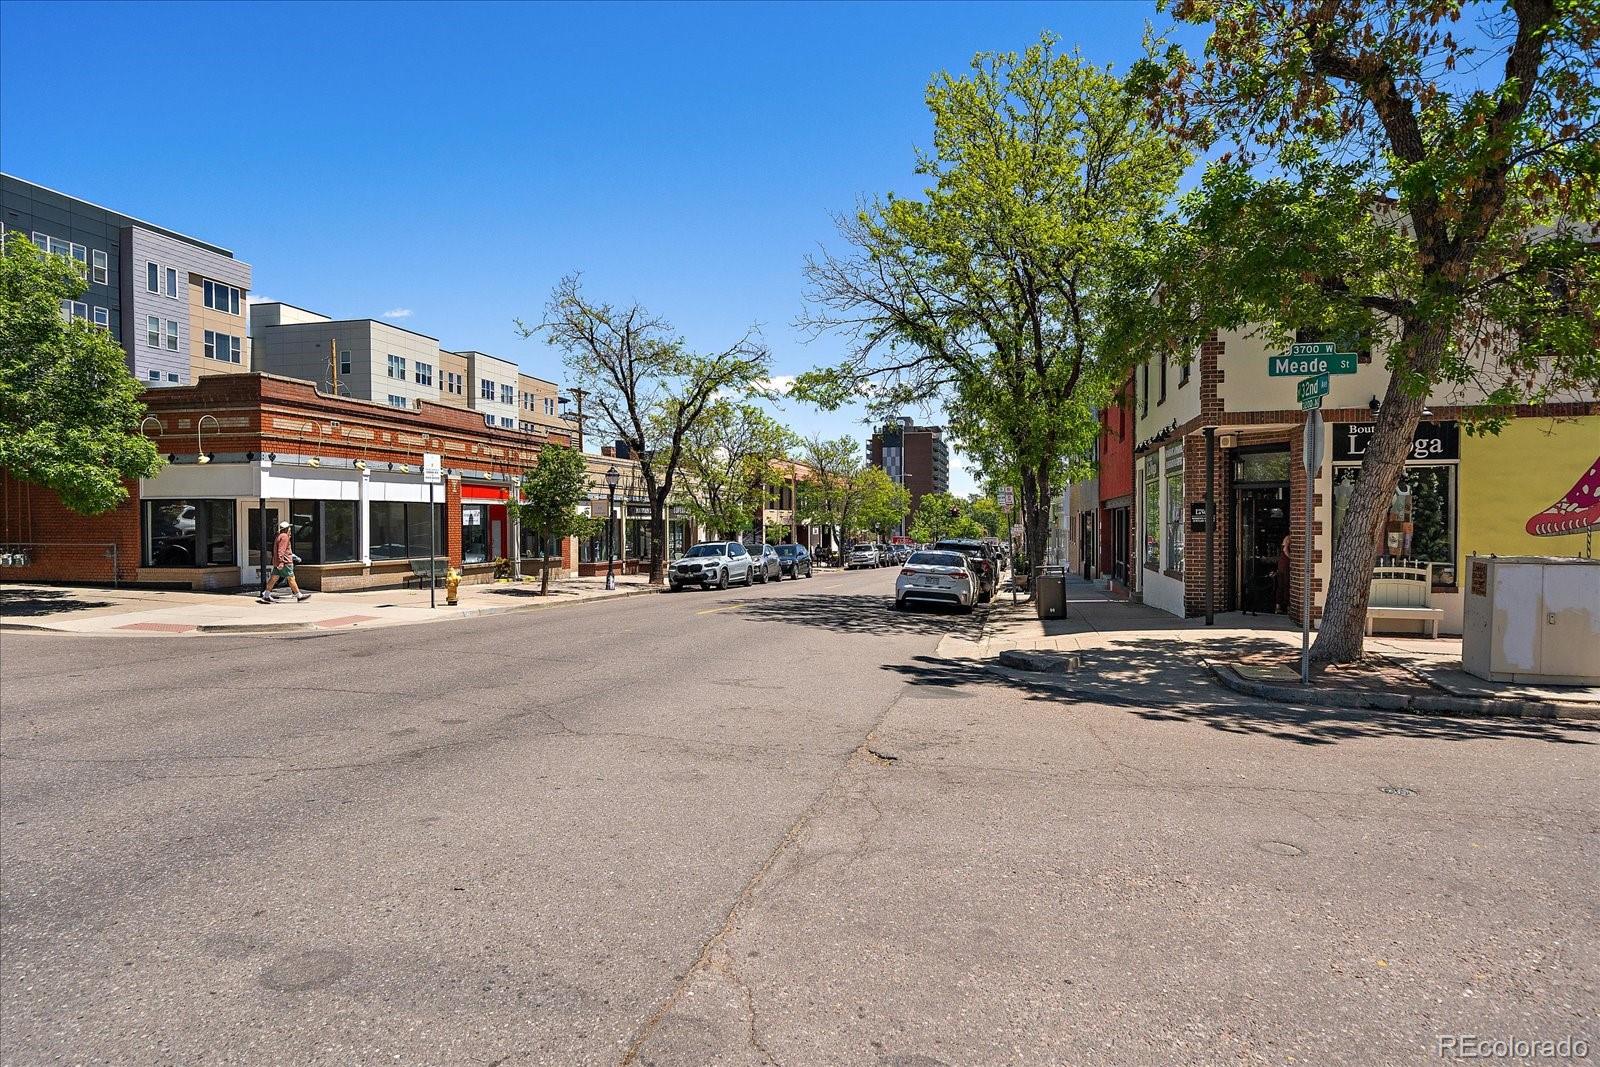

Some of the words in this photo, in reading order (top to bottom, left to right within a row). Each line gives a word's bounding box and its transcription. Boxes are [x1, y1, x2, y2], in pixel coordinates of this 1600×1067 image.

[1293, 345, 1319, 354] 3700
[1325, 345, 1334, 353] W
[1275, 358, 1328, 373] Meade
[1340, 360, 1350, 369] St
[1301, 379, 1319, 398] 32nd
